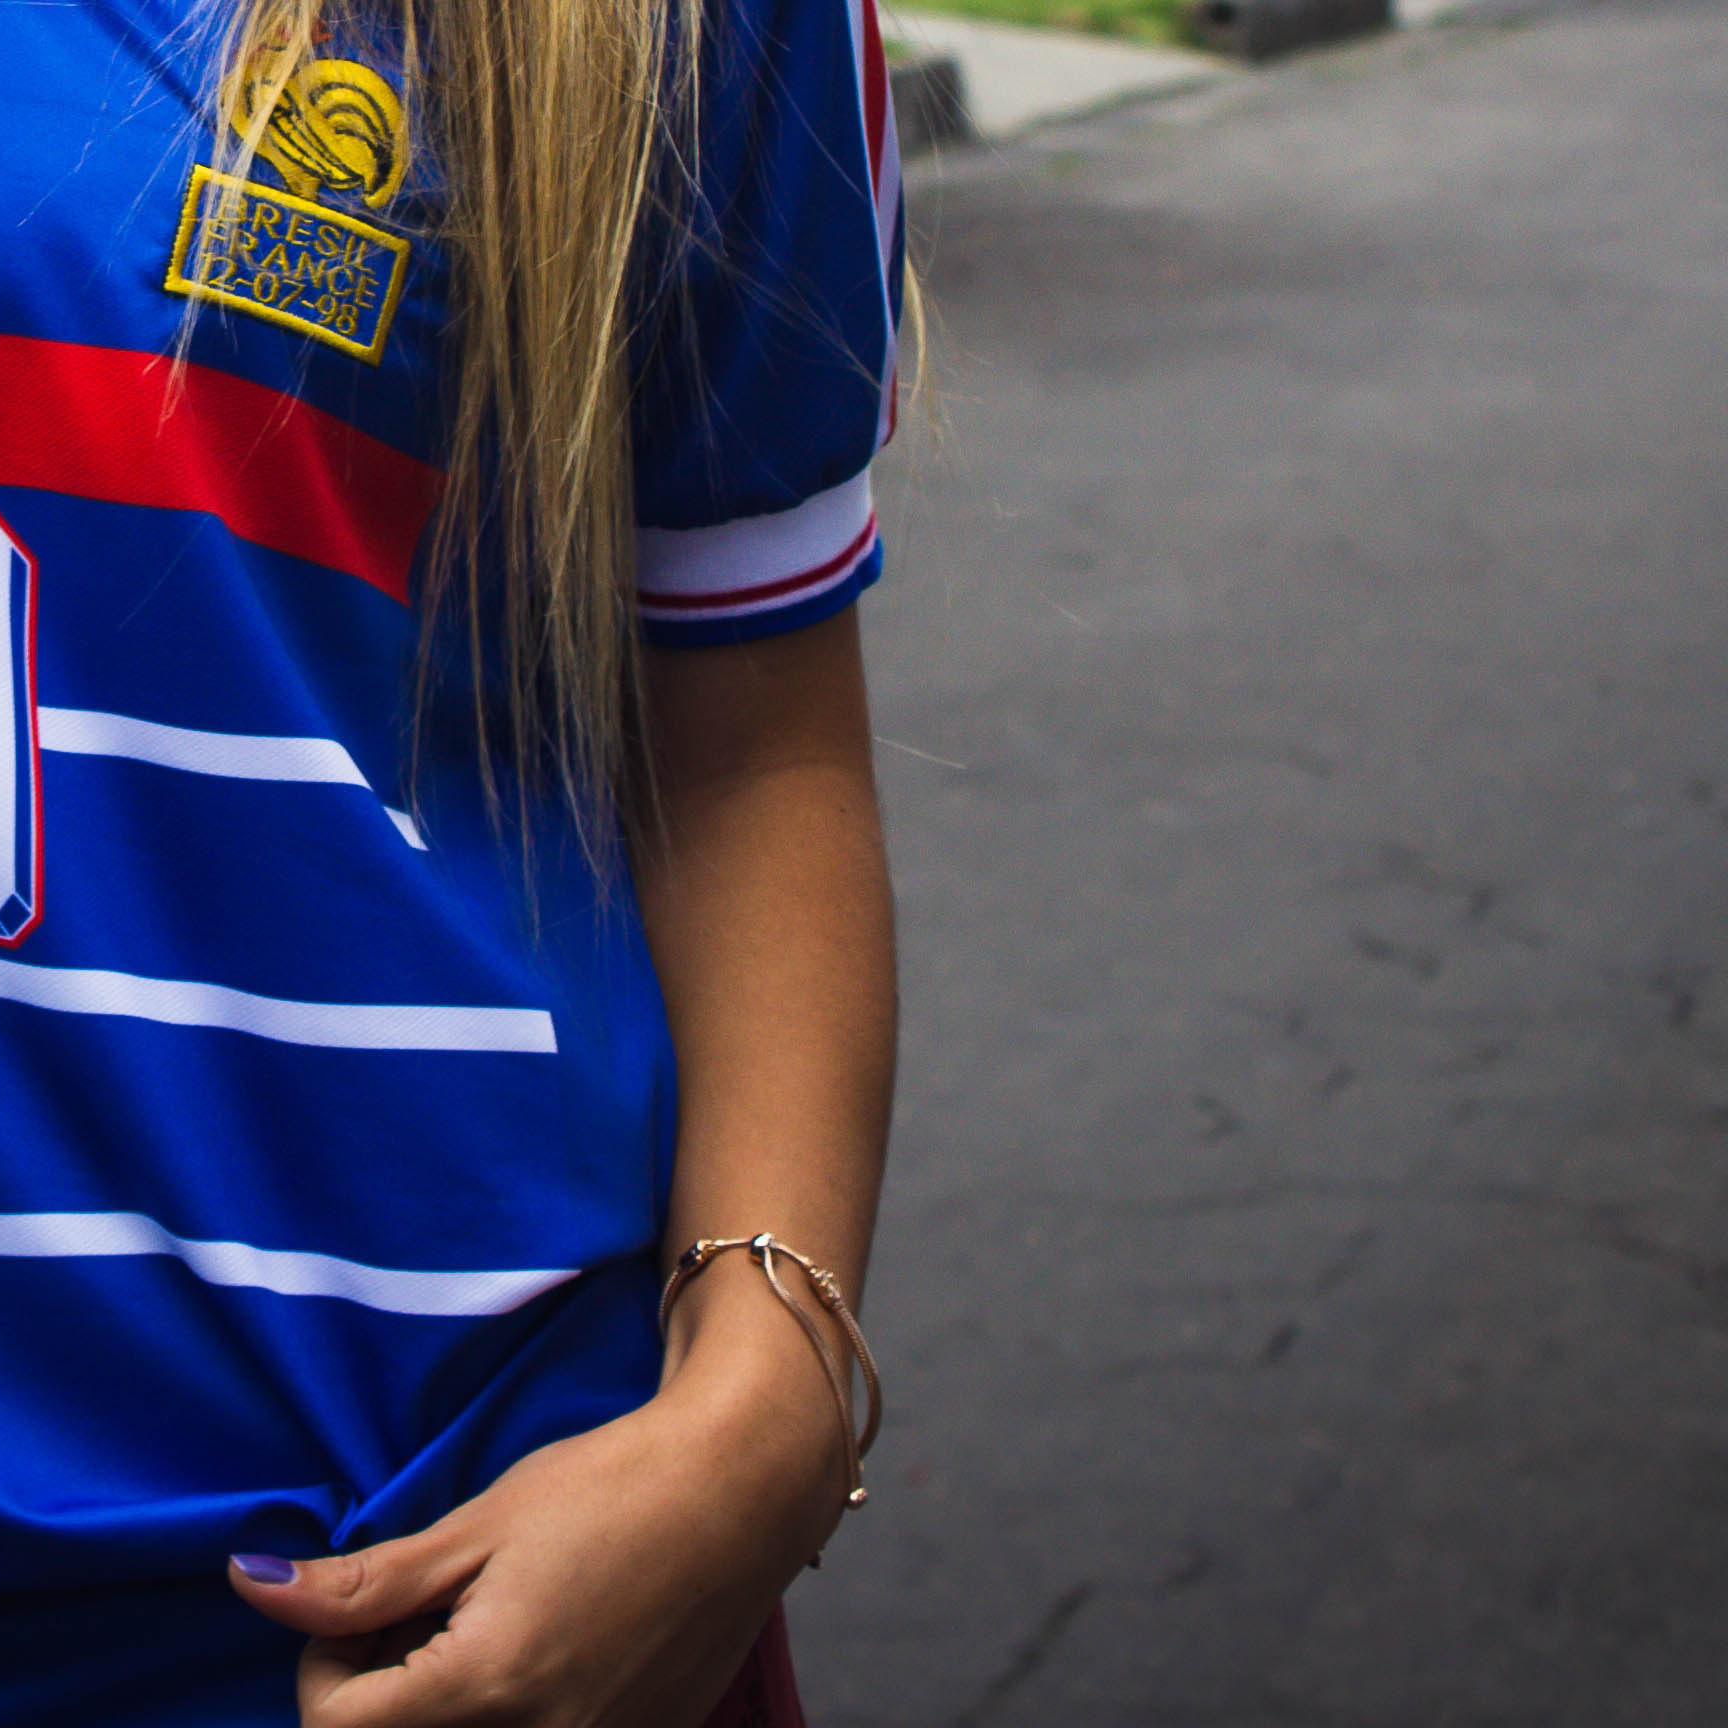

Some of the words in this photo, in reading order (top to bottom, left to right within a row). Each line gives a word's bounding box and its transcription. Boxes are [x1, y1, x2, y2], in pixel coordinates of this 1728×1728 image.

[200, 218, 379, 308] FRANCE
[216, 192, 376, 273] BRESIL
[199, 252, 359, 335] 12-07-98
